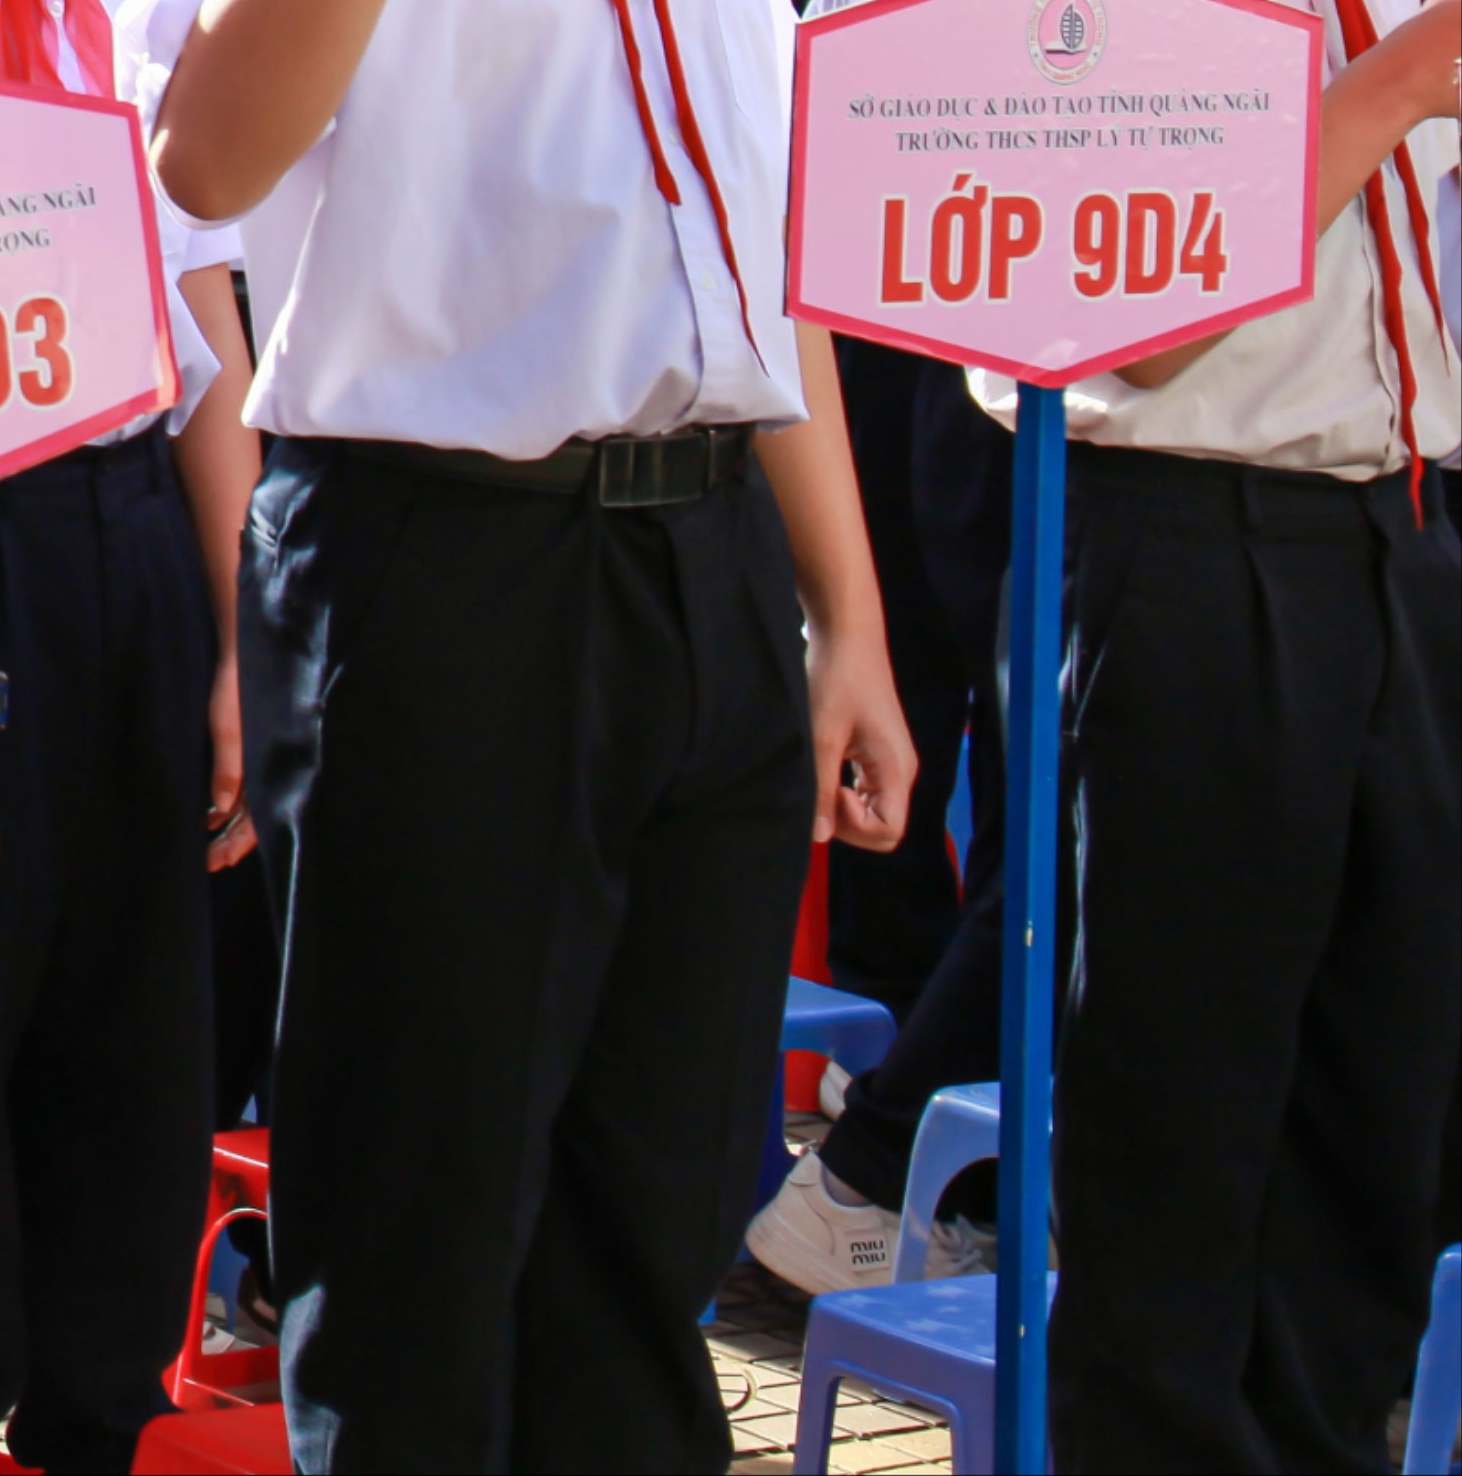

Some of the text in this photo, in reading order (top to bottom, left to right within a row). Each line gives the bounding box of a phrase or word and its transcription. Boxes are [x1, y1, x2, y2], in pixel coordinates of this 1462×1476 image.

[986, 130, 1037, 149] THCS
[1043, 128, 1091, 148] THSP
[882, 174, 1226, 302] LỚP 9D4
